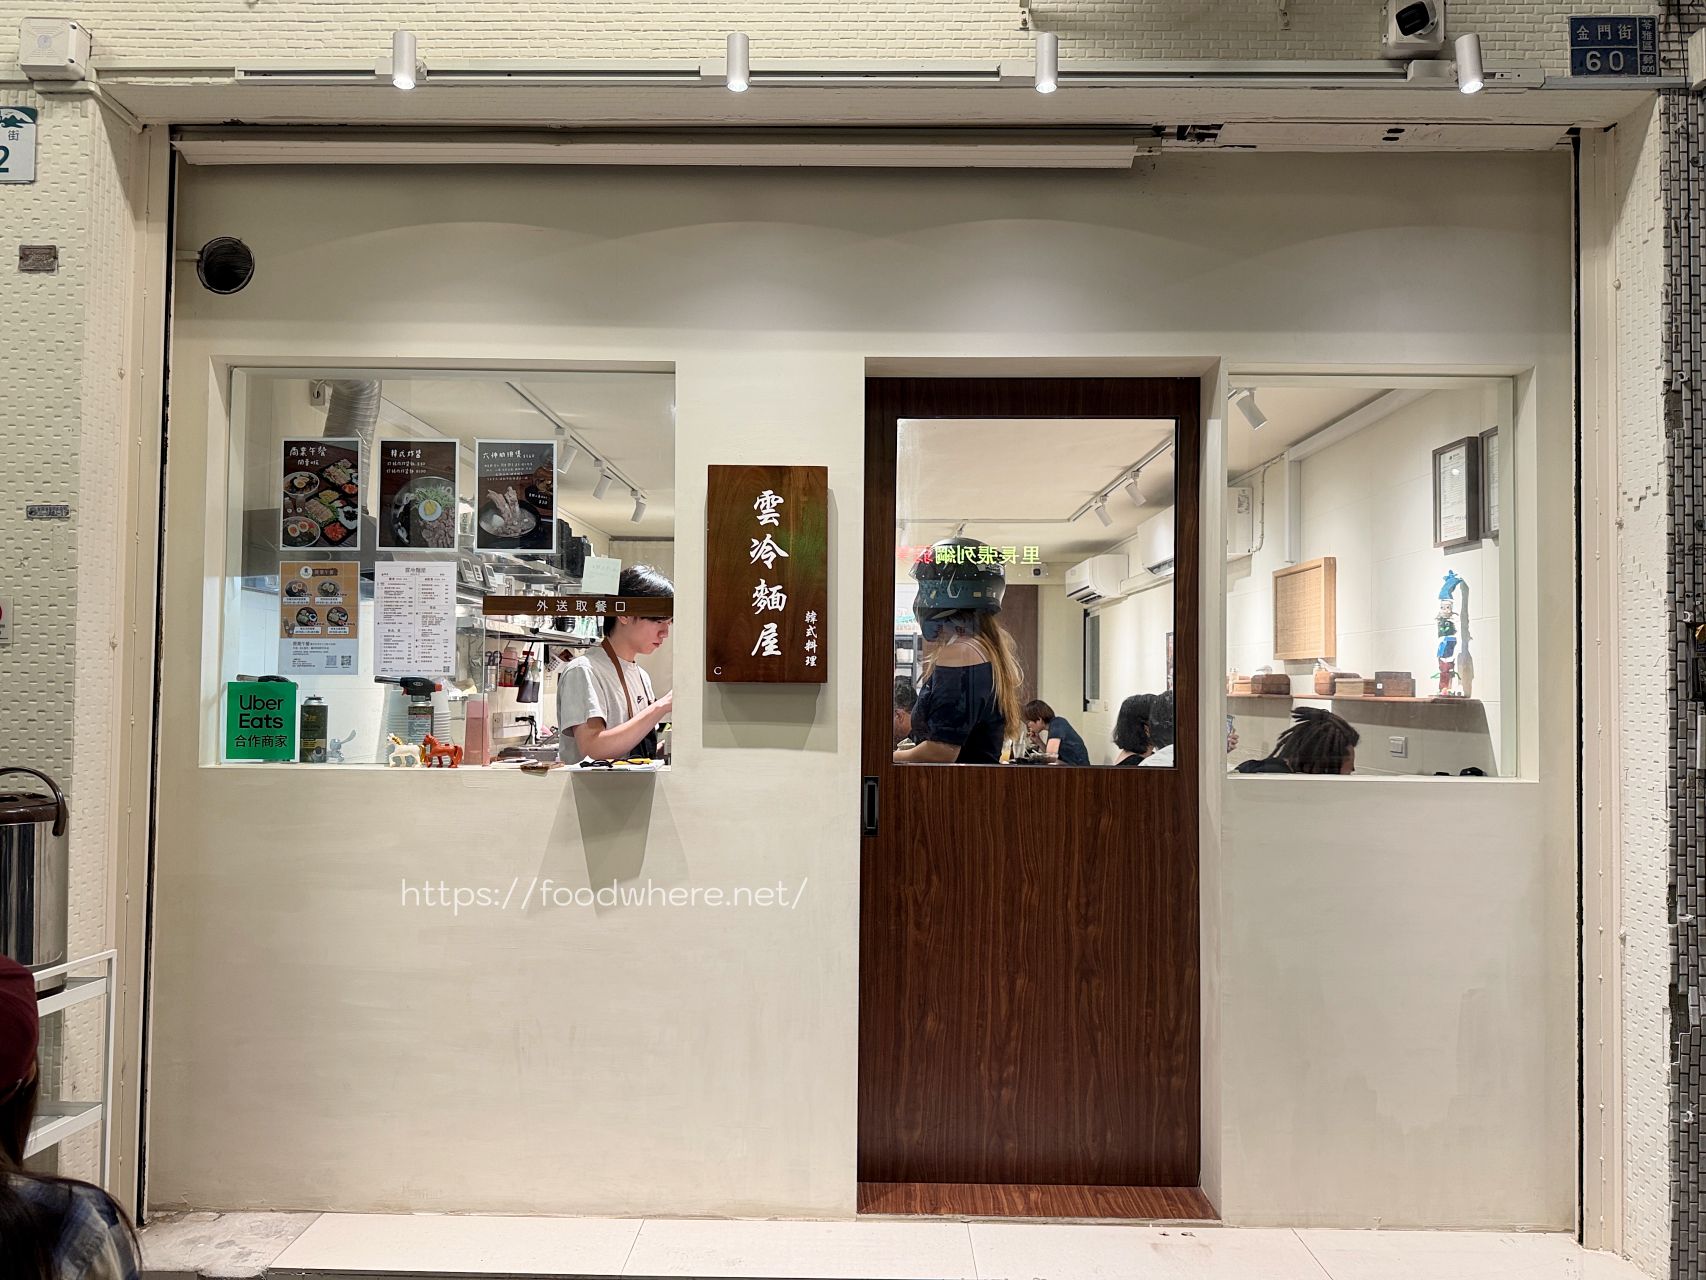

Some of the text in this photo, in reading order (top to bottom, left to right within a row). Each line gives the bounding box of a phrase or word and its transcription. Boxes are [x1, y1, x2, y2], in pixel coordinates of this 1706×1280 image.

[1576, 24, 1632, 41] 金門街
[1641, 19, 1654, 51] 苓雅區
[1585, 50, 1625, 72] 60
[7, 130, 20, 142] 街
[749, 489, 790, 657] 雲冷麵屋
[536, 599, 627, 613] 外送取餐口
[803, 610, 819, 668] 韓式料理
[239, 694, 285, 711] Uber
[239, 713, 284, 729] Eats
[234, 734, 288, 748] 合作商家
